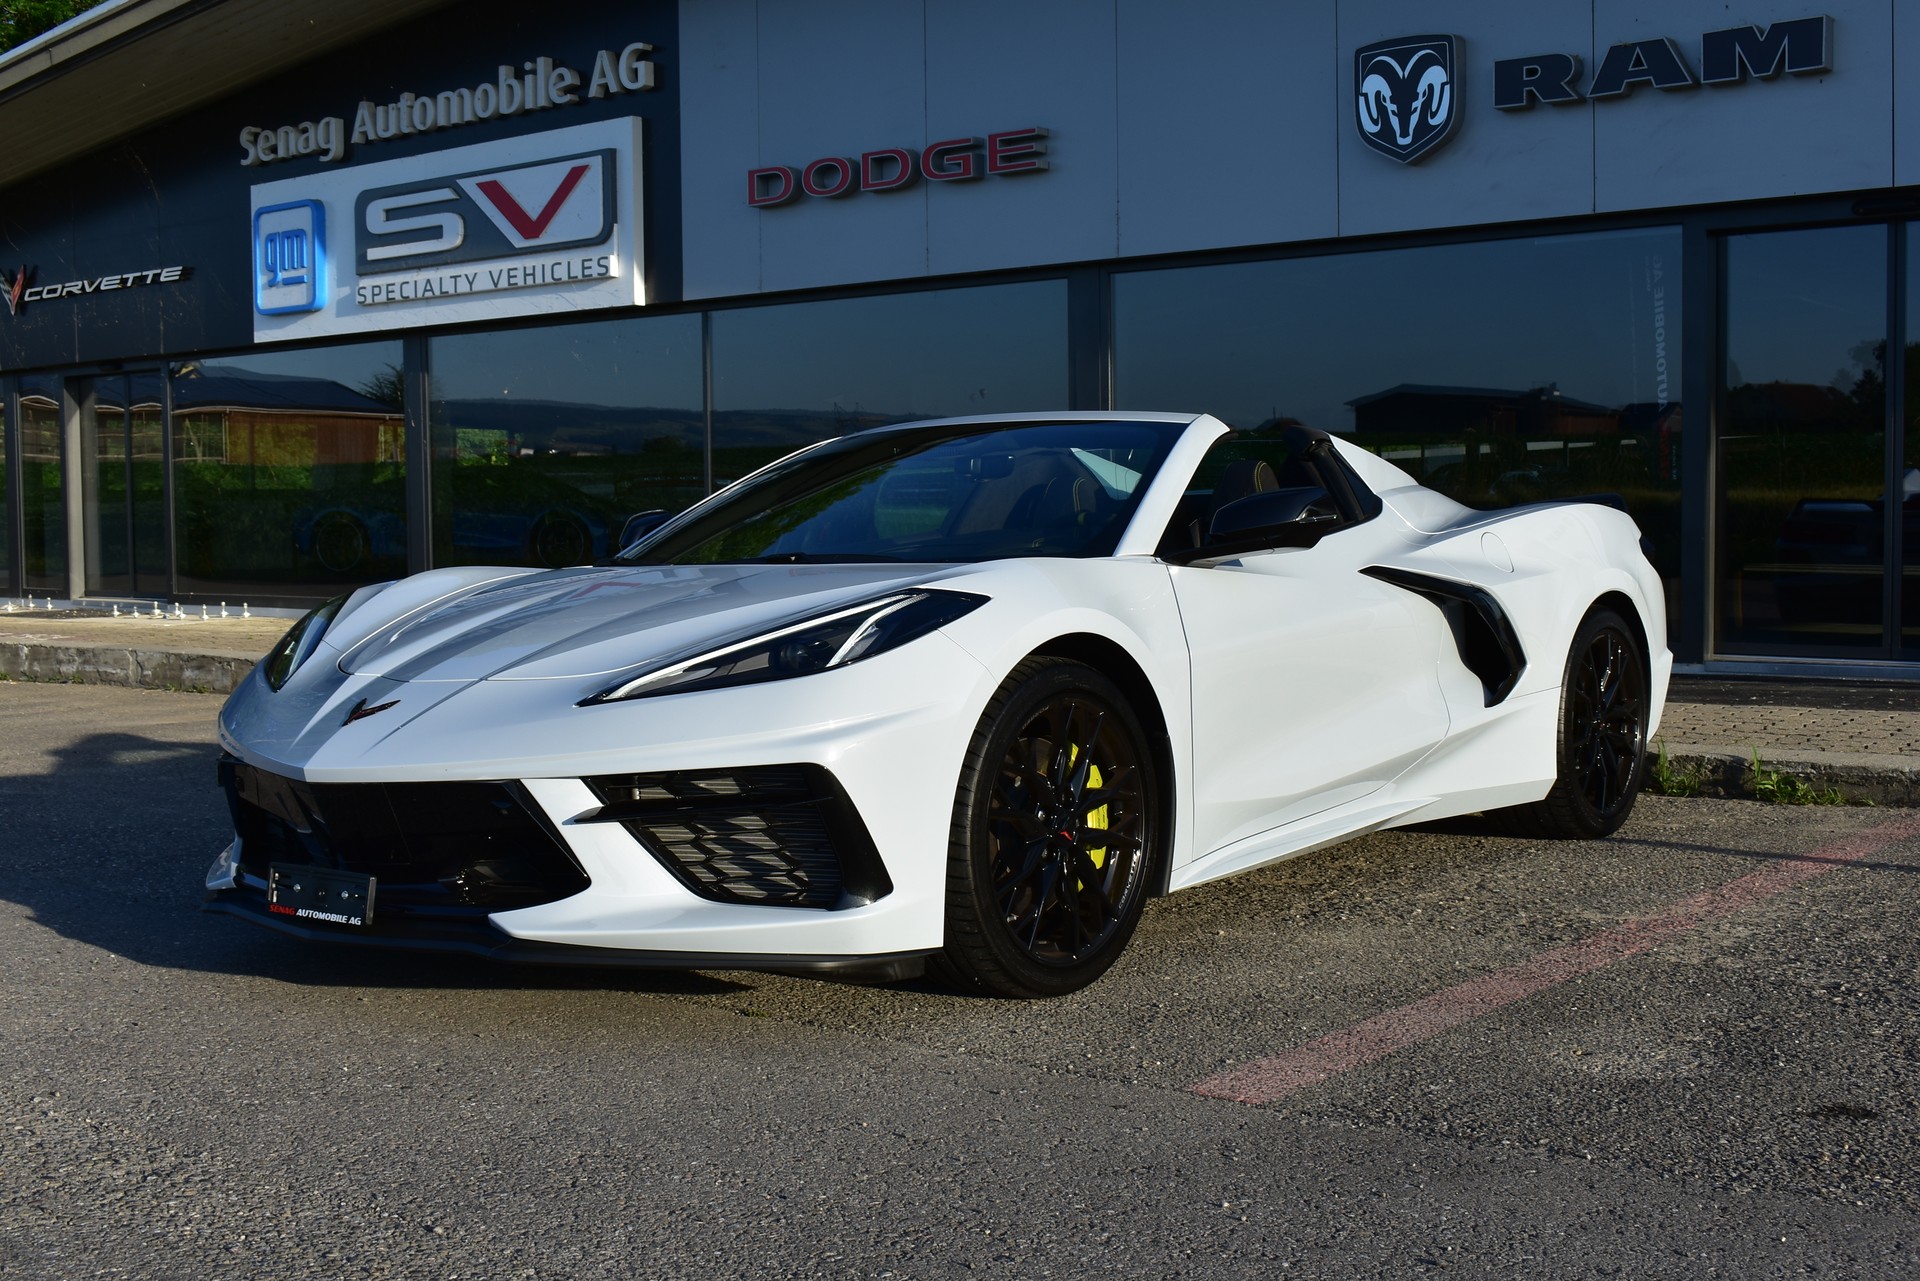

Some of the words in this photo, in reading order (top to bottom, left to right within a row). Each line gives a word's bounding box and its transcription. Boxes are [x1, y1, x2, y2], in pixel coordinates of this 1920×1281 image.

[1493, 13, 1834, 110] RAM
[240, 116, 344, 166] Senag
[350, 56, 580, 144] Automobile
[588, 42, 655, 98] AG
[747, 126, 1050, 208] DODGE
[365, 163, 591, 262] SV
[23, 265, 184, 302] CORVETTE
[356, 271, 478, 306] SPECIALTY
[488, 256, 611, 291] VEHICLES
[269, 904, 296, 915] SENAG
[296, 908, 348, 924] AUTOMOBILE
[348, 916, 362, 926] AG
